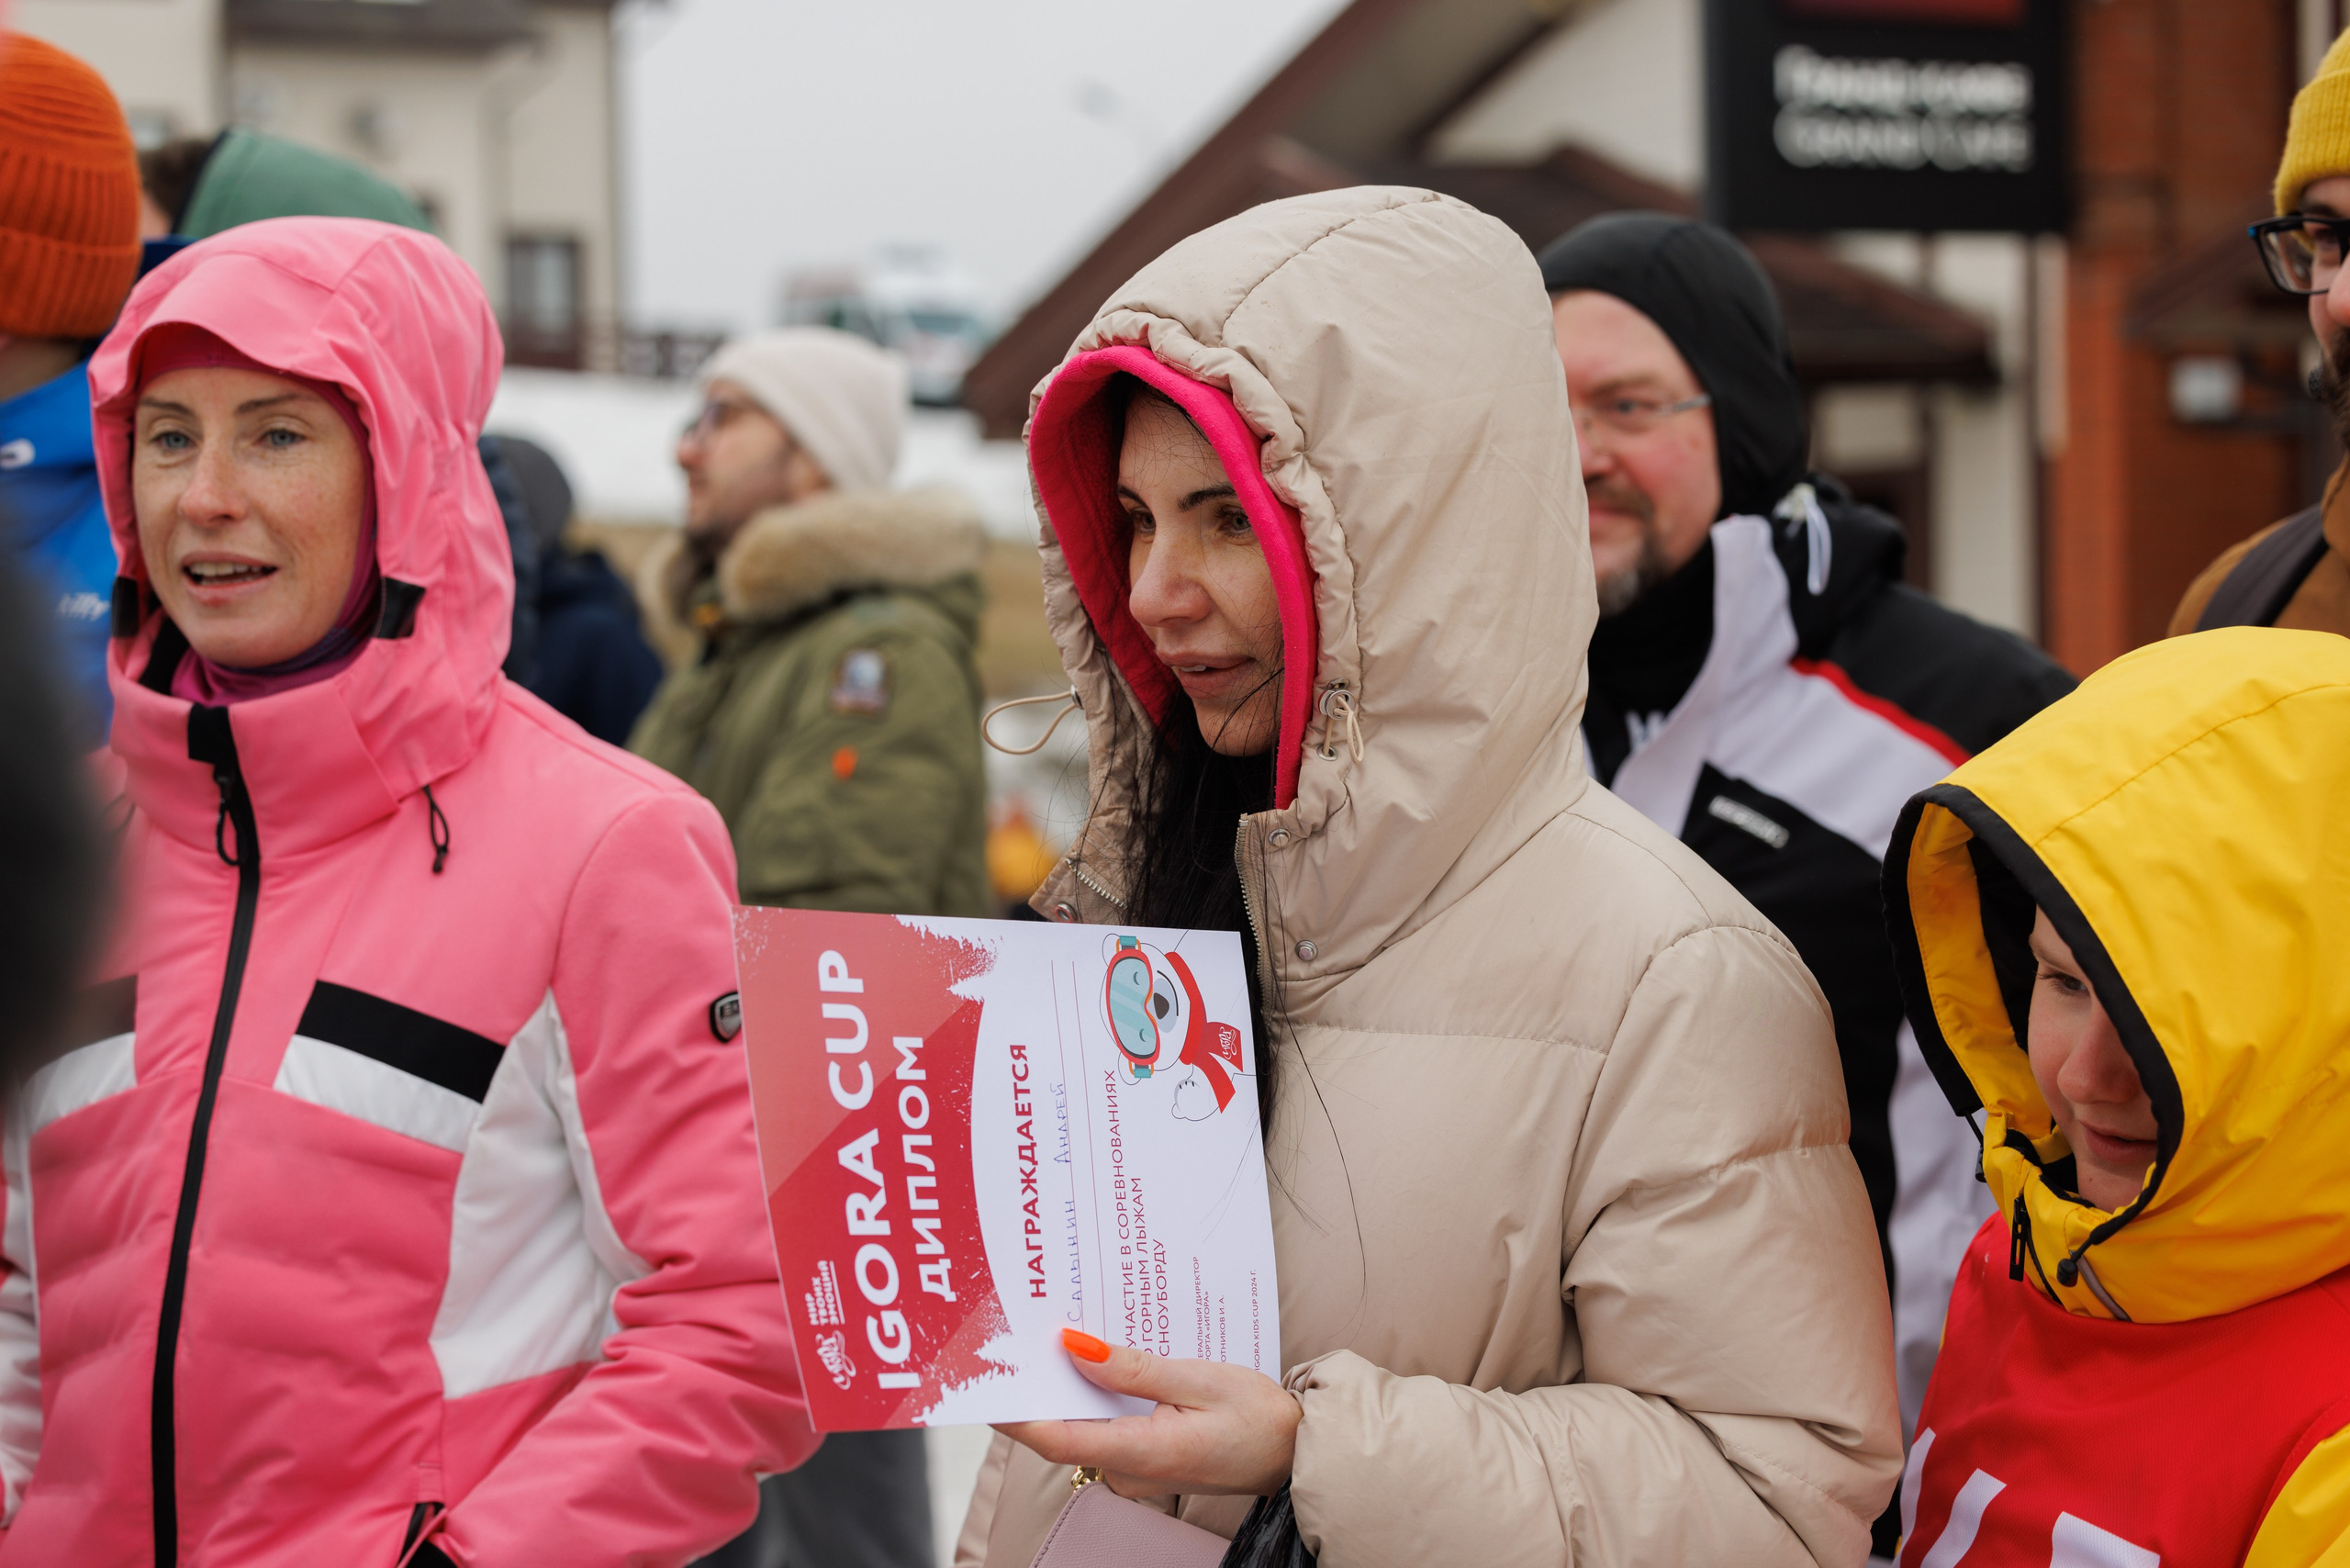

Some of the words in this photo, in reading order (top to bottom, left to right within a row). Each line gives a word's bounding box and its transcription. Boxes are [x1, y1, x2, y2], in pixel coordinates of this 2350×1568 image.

[818, 949, 874, 1110] CUP
[892, 1036, 957, 1302] ДИПЛОМ
[1010, 1044, 1046, 1298] НАГРАЖДАЕТСЯ
[1104, 1070, 1130, 1239] СОРЕВНОВАНИЯХ
[1120, 1245, 1132, 1255] В
[1131, 1178, 1148, 1254] ЛЫЖАМ
[817, 1260, 839, 1326] ЭМОЦИЙ
[837, 1128, 922, 1389] IGORA
[1153, 1238, 1170, 1357] СНОУБОРДУ
[1192, 1257, 1203, 1305] ДИРЕКТОР
[805, 1293, 819, 1326] МИР
[811, 1277, 829, 1326] ТВОИХ
[1121, 1261, 1136, 1348] УЧАСТИЕ
[1138, 1260, 1153, 1342] ГОРНЫМ
[1195, 1307, 1203, 1359] ЕРАЛЬНЫЙ
